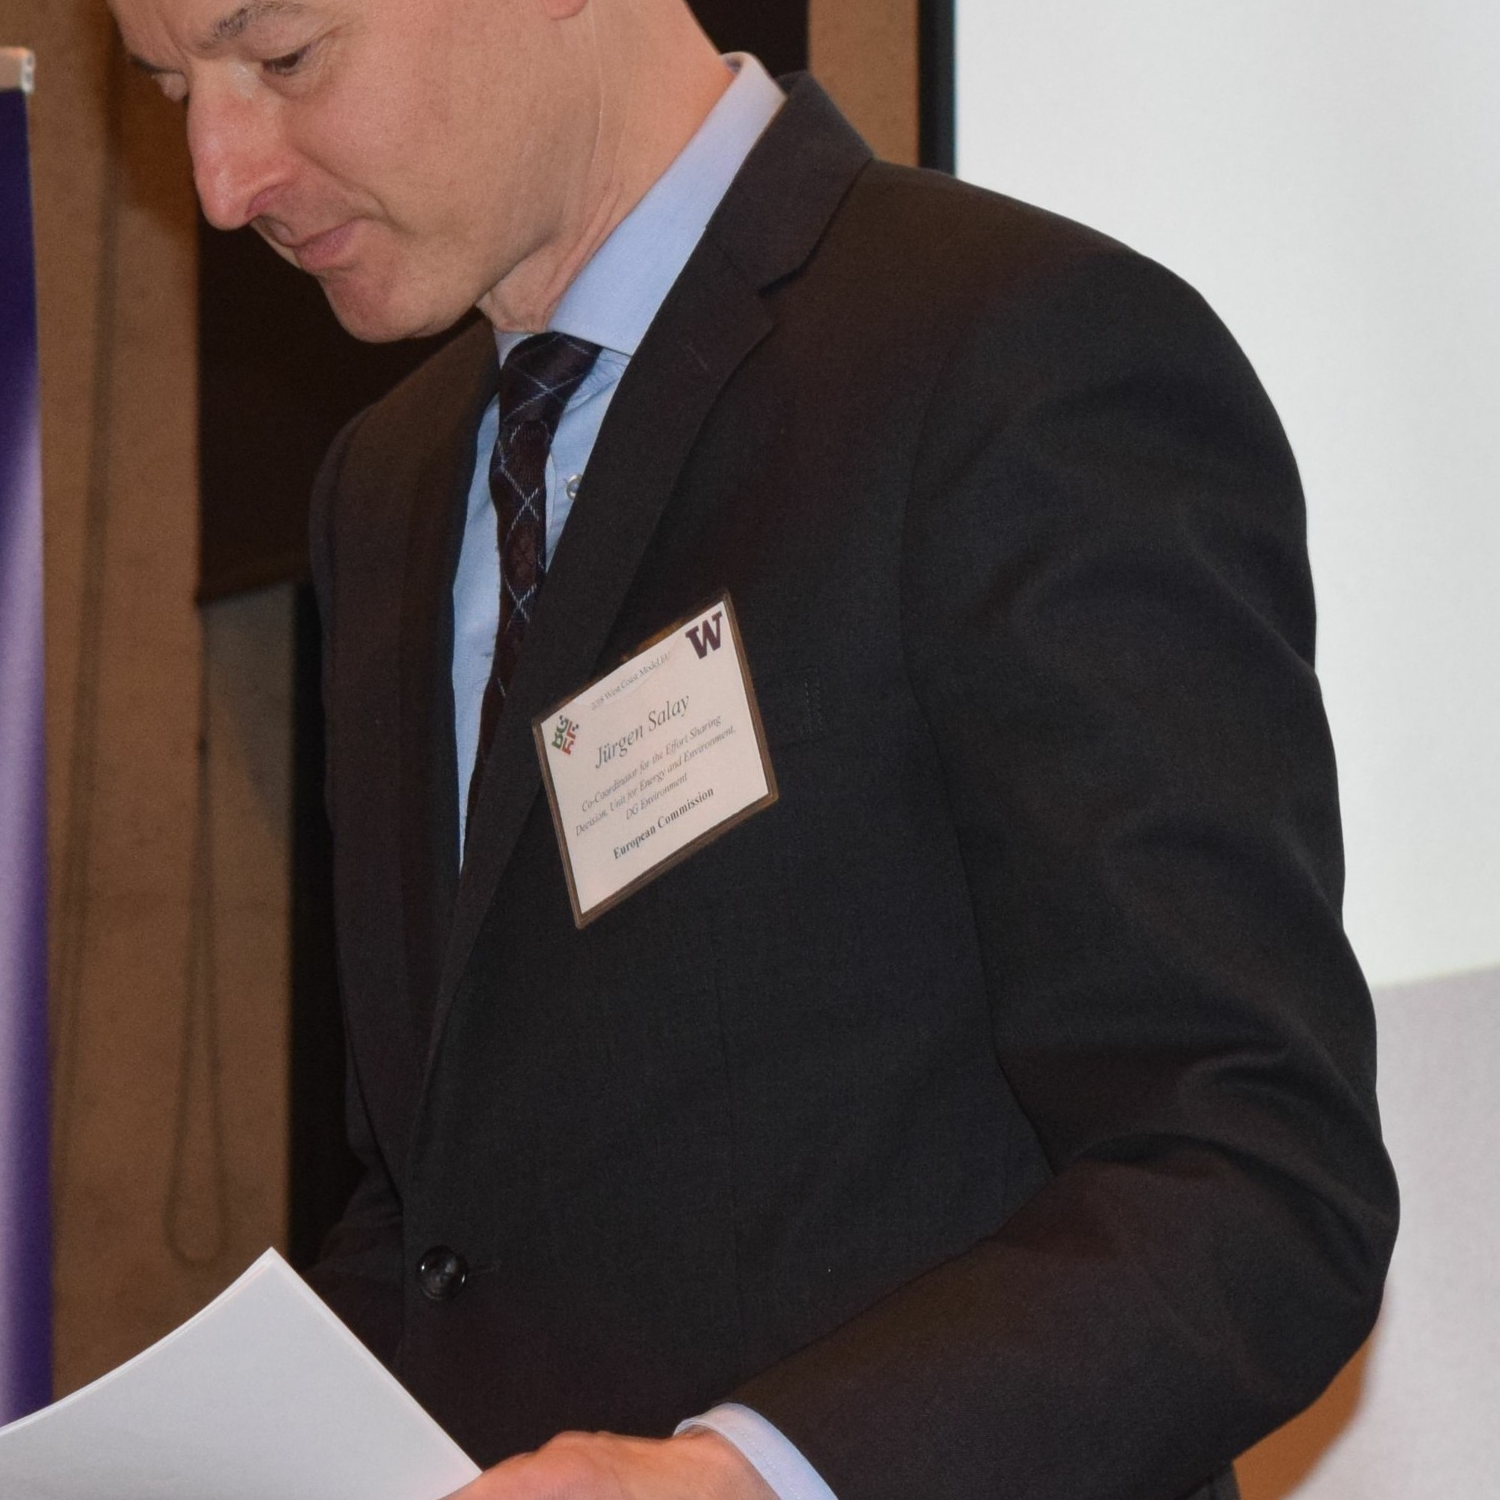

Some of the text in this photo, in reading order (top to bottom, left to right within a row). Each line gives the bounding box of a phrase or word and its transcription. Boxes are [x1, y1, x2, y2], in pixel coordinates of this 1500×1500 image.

[685, 611, 722, 659] W
[595, 725, 643, 769] Jürgen
[647, 695, 689, 731] Salay
[689, 715, 721, 739] Sharing
[639, 769, 665, 791] Energy
[667, 755, 682, 773] and
[640, 772, 687, 810] Environment
[612, 788, 713, 859] European Commission
